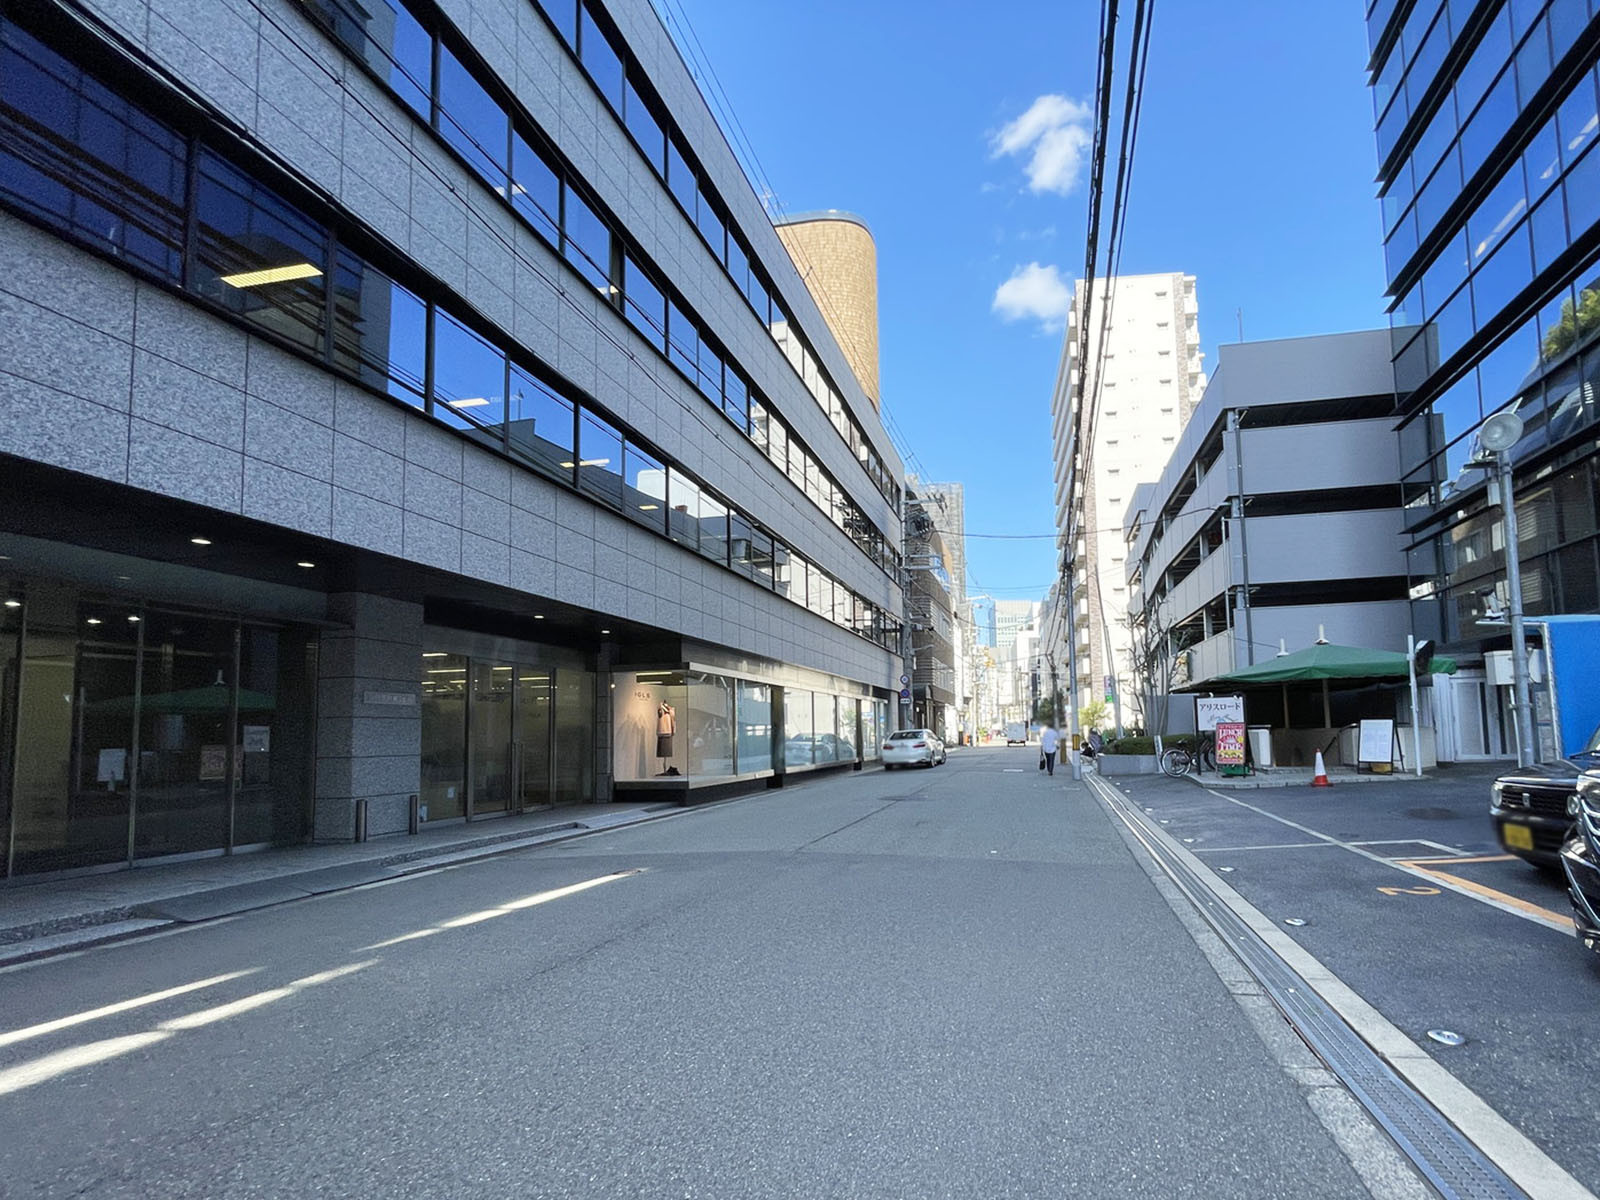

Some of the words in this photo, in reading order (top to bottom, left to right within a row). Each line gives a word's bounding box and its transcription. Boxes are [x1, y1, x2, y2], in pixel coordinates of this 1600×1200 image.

[1199, 703, 1241, 711] アリスロード
[1219, 729, 1242, 738] LUNCH
